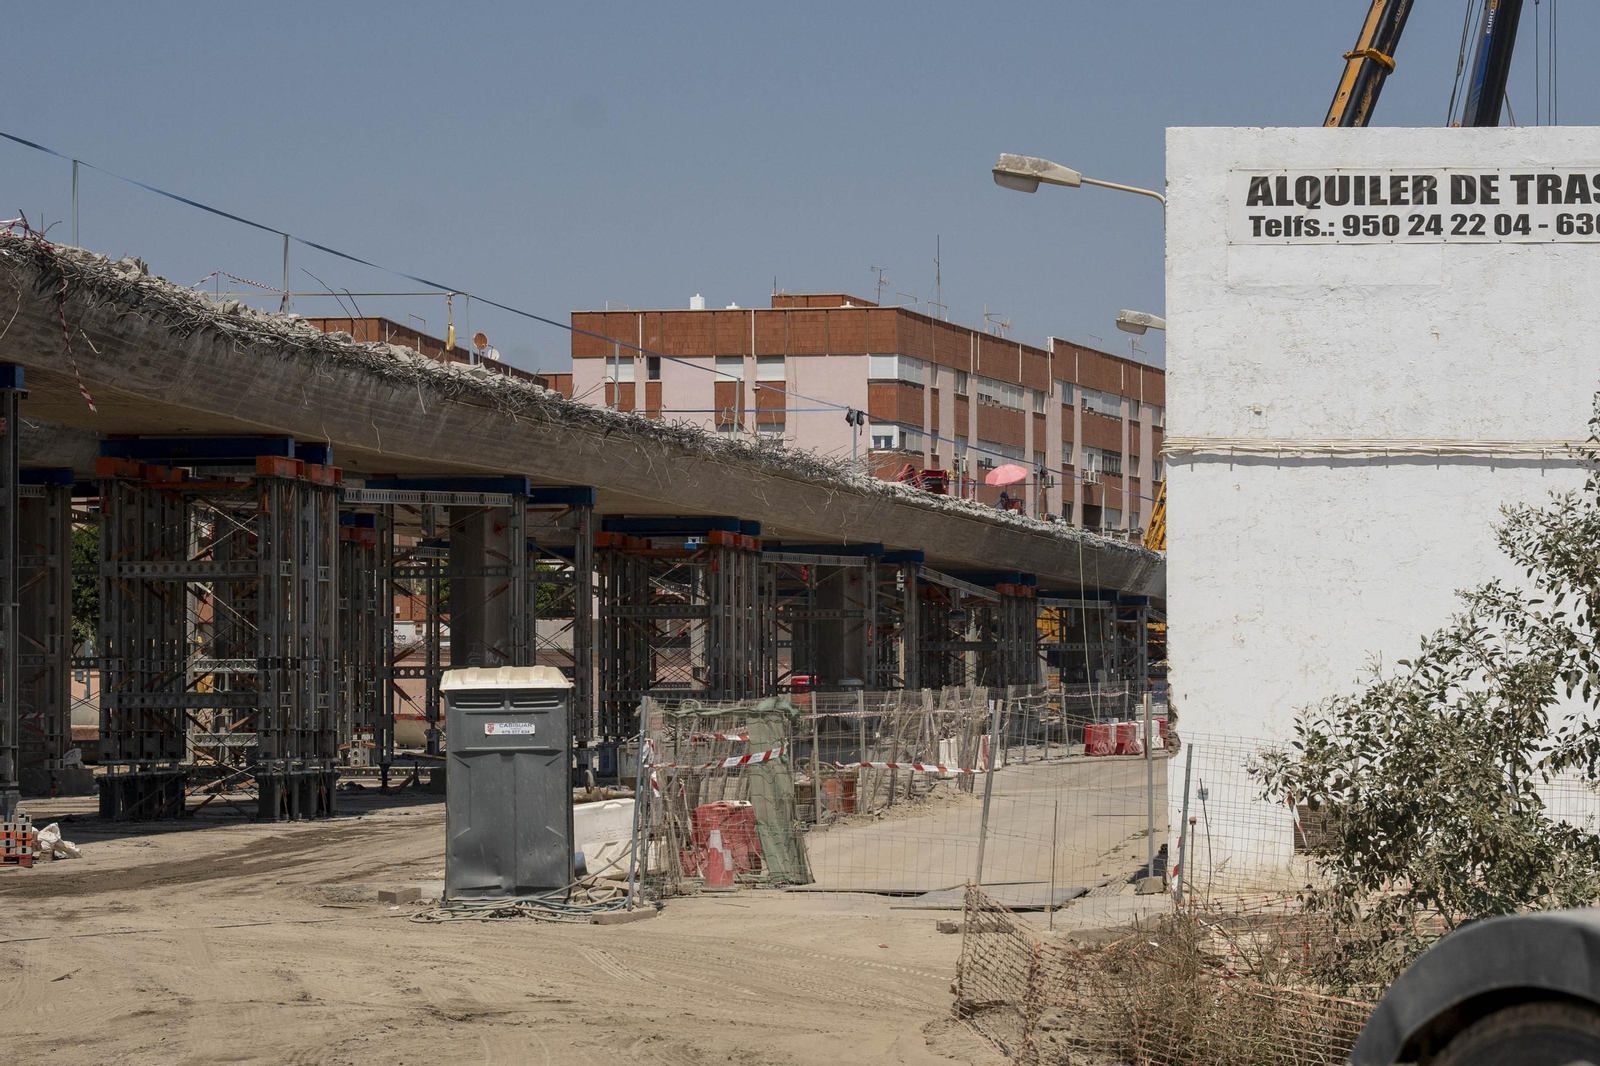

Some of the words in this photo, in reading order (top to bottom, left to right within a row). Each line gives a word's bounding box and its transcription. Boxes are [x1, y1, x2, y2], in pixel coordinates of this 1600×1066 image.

[1246, 175, 1438, 209] ALQUILER
[1450, 174, 1500, 205] DE
[1510, 174, 1600, 205] TRA
[1249, 215, 1335, 237] Telfs.:
[1342, 214, 1400, 237] 950
[1408, 214, 1443, 236] 24
[1450, 213, 1486, 236] 22
[1494, 213, 1532, 236] 04
[1556, 213, 1600, 235] 63
